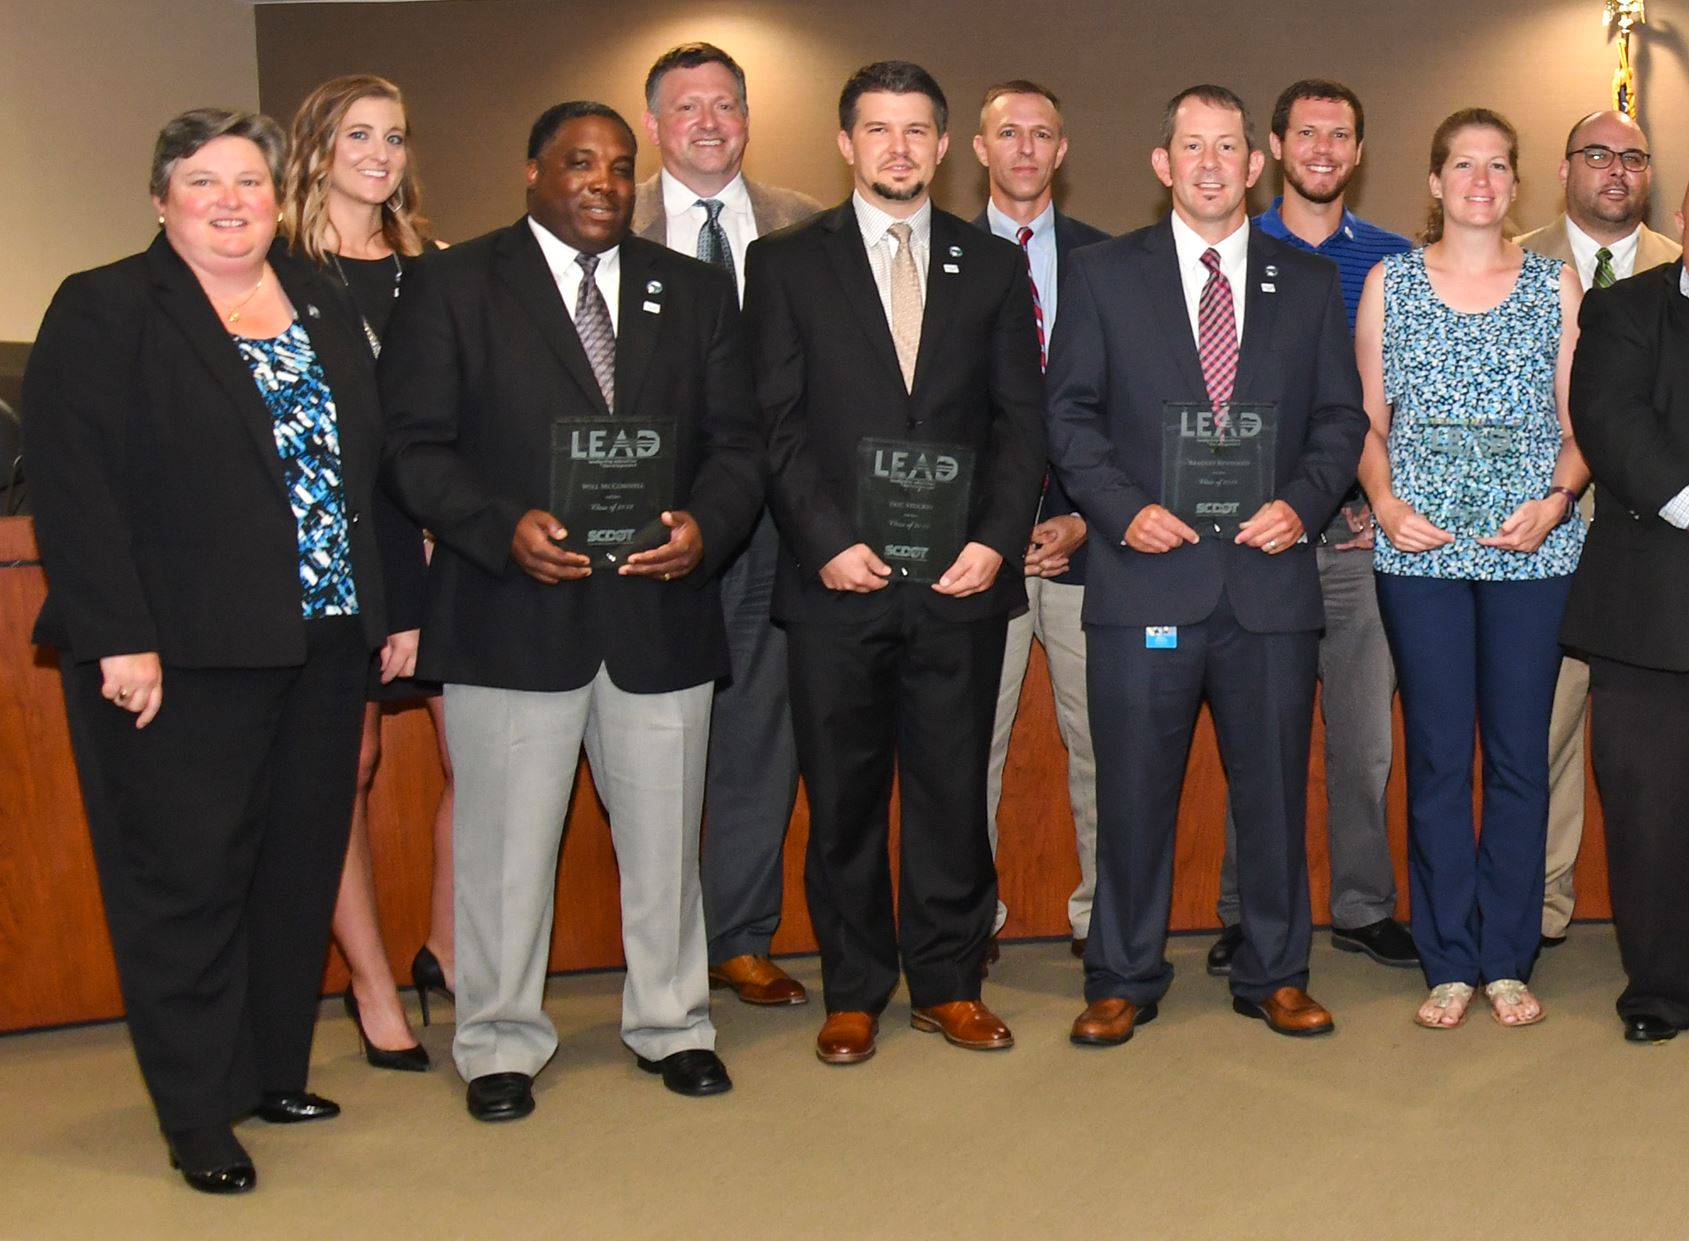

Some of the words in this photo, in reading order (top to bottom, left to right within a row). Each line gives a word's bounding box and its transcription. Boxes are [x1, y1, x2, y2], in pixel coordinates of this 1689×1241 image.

[1180, 410, 1263, 438] LEAD
[571, 429, 661, 459] LEAD
[874, 450, 959, 482] LEAD
[1195, 502, 1240, 515] SCDOT
[587, 529, 636, 543] SCDOT
[884, 545, 930, 560] SCDOT
